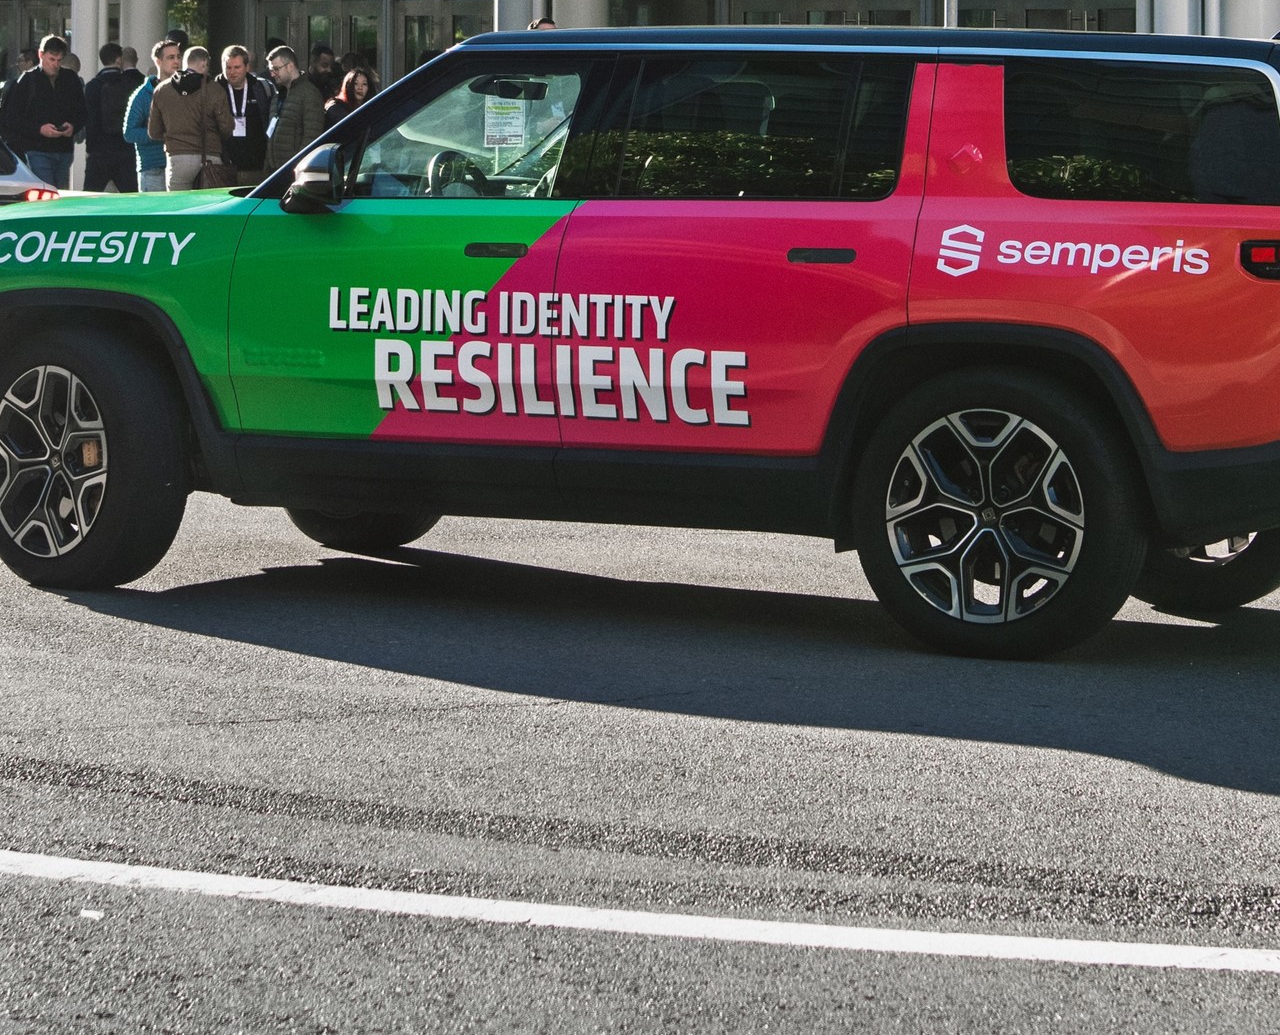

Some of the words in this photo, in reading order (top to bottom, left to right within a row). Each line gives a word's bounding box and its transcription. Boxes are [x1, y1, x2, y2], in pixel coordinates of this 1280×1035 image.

[997, 239, 1210, 275] semperis
[329, 286, 488, 335] LEADING
[498, 291, 676, 342] IDENTITY
[374, 337, 752, 427] RESILIENCE
